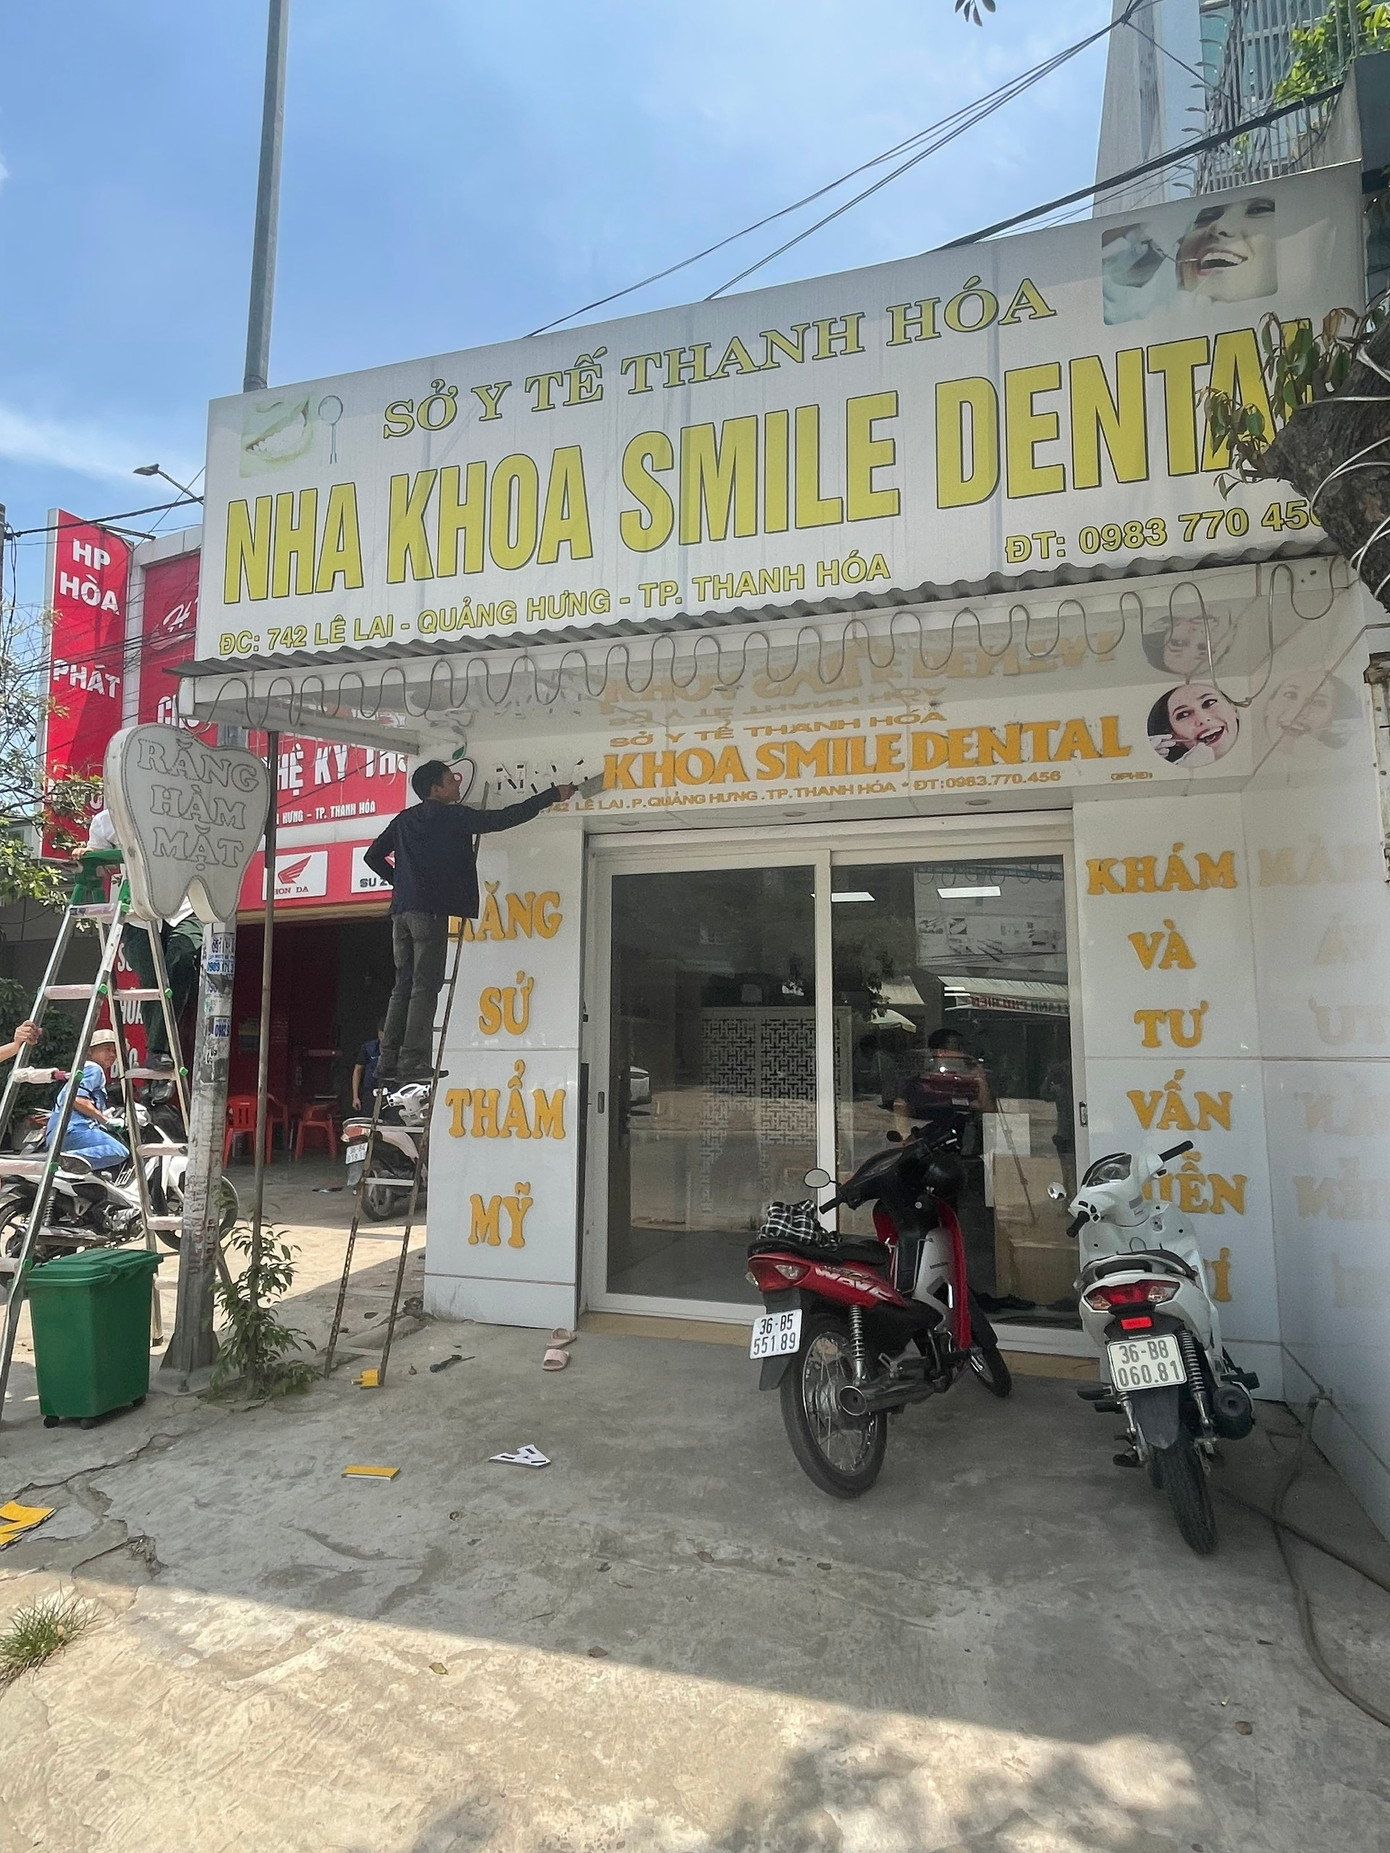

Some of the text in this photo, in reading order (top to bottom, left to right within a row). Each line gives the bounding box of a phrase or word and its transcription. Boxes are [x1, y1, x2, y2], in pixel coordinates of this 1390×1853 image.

[383, 275, 1057, 440] SỞ Y TẾ THANH HÓA
[223, 483, 365, 605] NHA
[386, 445, 594, 585] KHOA
[619, 390, 901, 553] SMILE
[72, 538, 111, 571] HP
[1005, 530, 1067, 564] ĐT:
[1078, 518, 1168, 554] 0983
[1179, 507, 1250, 542] 770
[60, 571, 120, 616] HÒA
[219, 630, 261, 656] ĐC:
[267, 625, 308, 651] 742
[315, 614, 346, 646] LÊ
[354, 614, 394, 641] LAI
[417, 597, 518, 635] QUẢNG
[526, 589, 612, 623] HƯNG
[638, 580, 683, 608] TP.
[693, 564, 806, 601] THANH
[817, 550, 891, 587] HÓA
[602, 715, 1133, 790] KHOA SMILE DENTAL
[609, 730, 653, 747] SỞ
[665, 732, 686, 743] Y
[743, 718, 861, 738] THANH
[869, 708, 948, 727] HÓA
[137, 738, 260, 793] RĂNG
[858, 779, 897, 795] HÓA
[150, 784, 247, 830] HÀM
[330, 803, 357, 819] THANH
[359, 799, 376, 815] HÓA
[152, 824, 245, 872] MẶT
[1086, 842, 1238, 895] KHÁM
[1128, 918, 1196, 970] VÀ
[478, 970, 534, 1036] SỬ
[1134, 1000, 1210, 1049] TƯ
[445, 1059, 567, 1140] THẨM
[1127, 1068, 1233, 1131] VẤN
[468, 1182, 534, 1249] MỸ
[759, 1313, 794, 1335] 36-B5
[1118, 1361, 1180, 1388] 060.81
